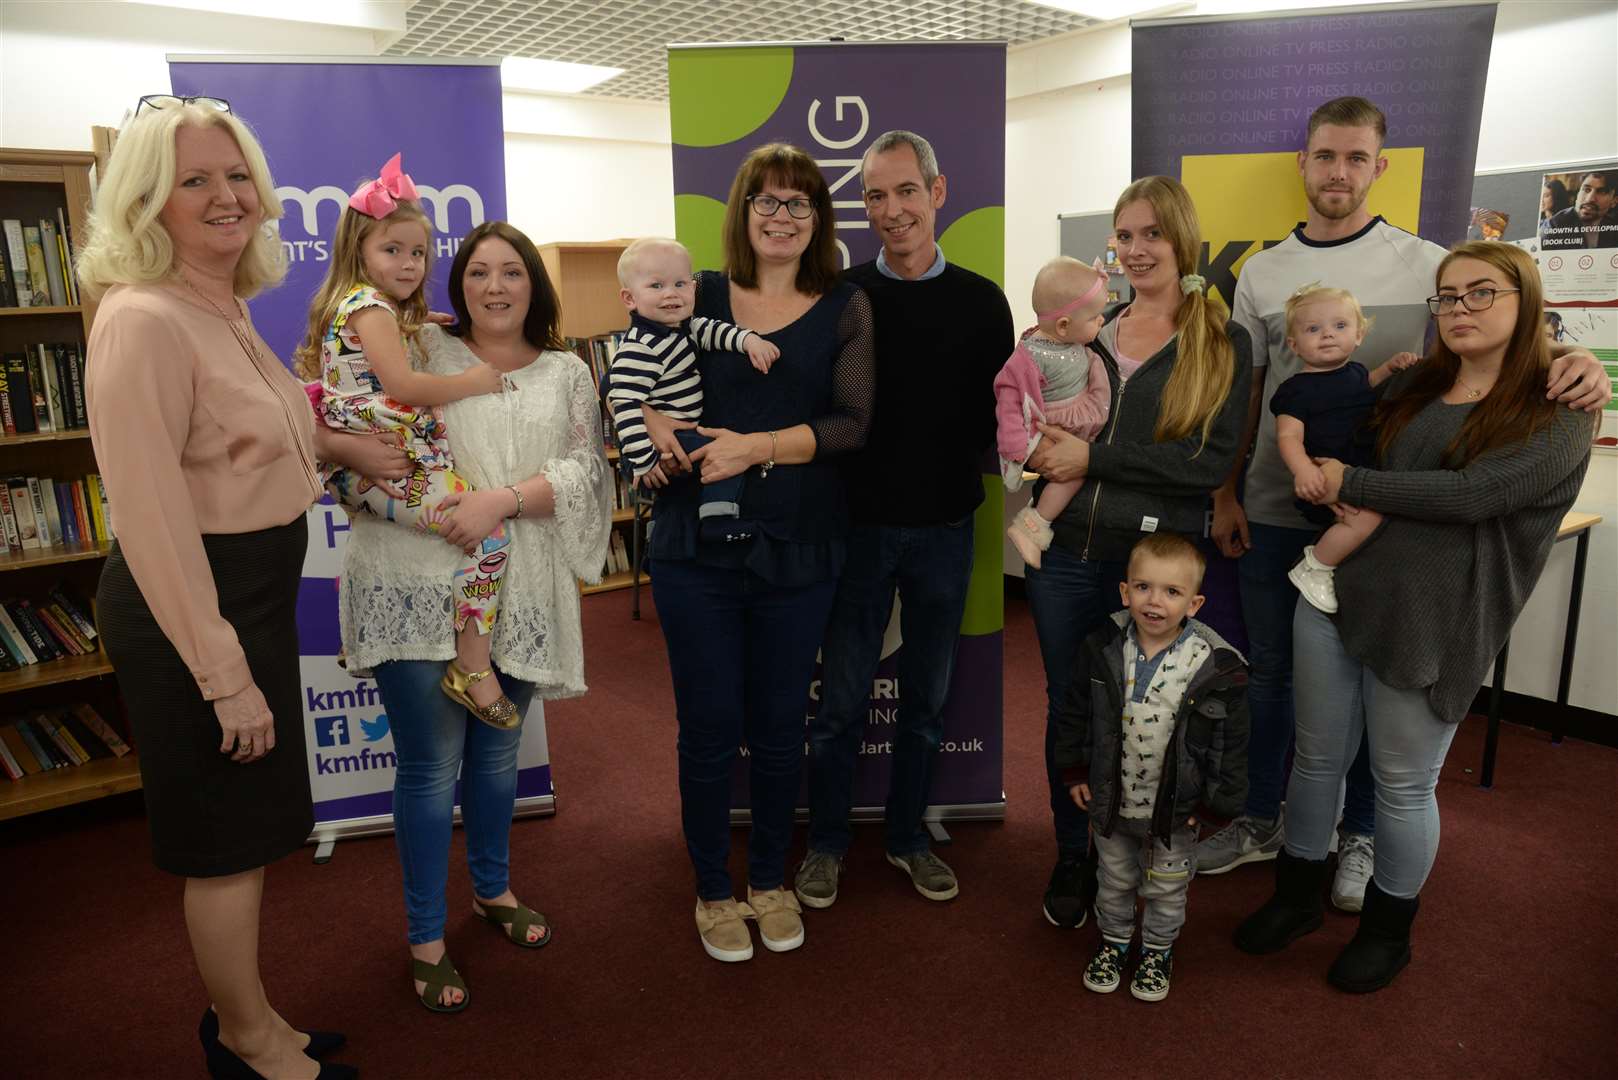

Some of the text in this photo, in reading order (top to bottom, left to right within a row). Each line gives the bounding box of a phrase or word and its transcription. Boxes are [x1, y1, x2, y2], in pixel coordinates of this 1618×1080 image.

[1287, 21, 1304, 33] TV
[1310, 18, 1352, 32] PRESS
[1285, 42, 1305, 55] TV
[1308, 40, 1351, 54] PRESS
[1355, 35, 1407, 51] RADIO
[1221, 65, 1280, 80] ONLINE
[1283, 64, 1304, 76] TV
[1307, 62, 1350, 76] PRESS
[1354, 58, 1406, 73] RADIO
[1221, 87, 1279, 102] ONLINE
[1283, 86, 1302, 99] TV
[1306, 84, 1347, 98] PRESS
[1352, 80, 1404, 96] RADIO
[1219, 108, 1277, 123] ONLINE
[1280, 108, 1299, 121] TV
[1219, 131, 1277, 145] ONLINE
[1279, 129, 1300, 142] TV
[1543, 227, 1573, 235] GROWTH
[1542, 237, 1583, 247] (BOOK CLUB)
[31, 630, 46, 649] TIDE
